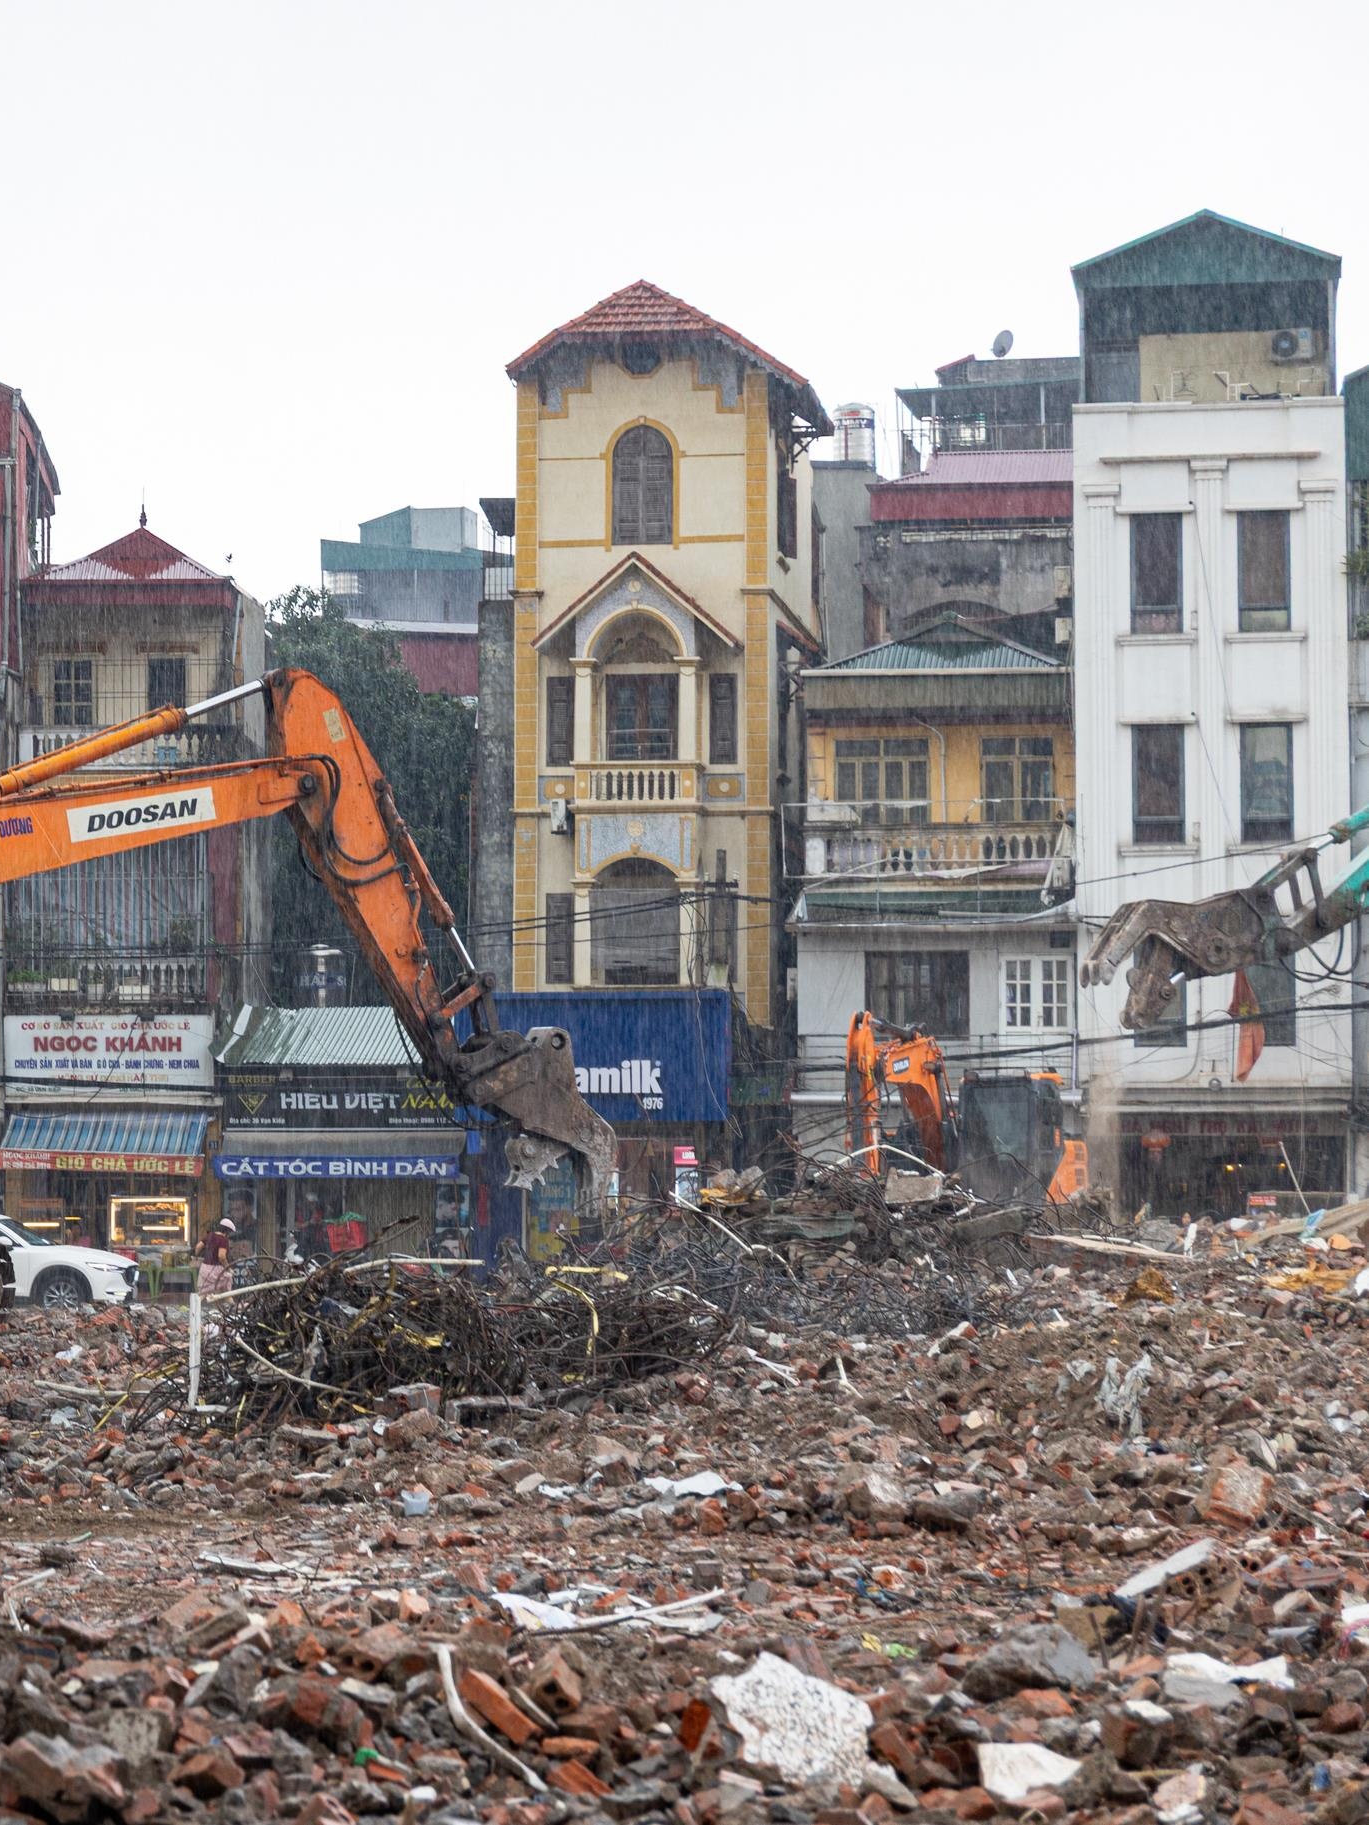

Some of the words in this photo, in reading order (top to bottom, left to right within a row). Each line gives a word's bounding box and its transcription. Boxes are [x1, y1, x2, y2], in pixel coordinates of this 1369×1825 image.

[87, 798, 198, 833] DOOSAN
[33, 1035, 98, 1053] NGỌC
[105, 1031, 182, 1053] KHÁNH
[642, 1096, 664, 1111] 1976
[55, 1154, 86, 1170] GIÒ
[91, 1154, 127, 1171] CHẢ
[221, 1156, 270, 1176] CẮT
[273, 1157, 323, 1176] TÓC
[329, 1157, 388, 1176] BÌNH
[395, 1158, 447, 1177] DÂN
